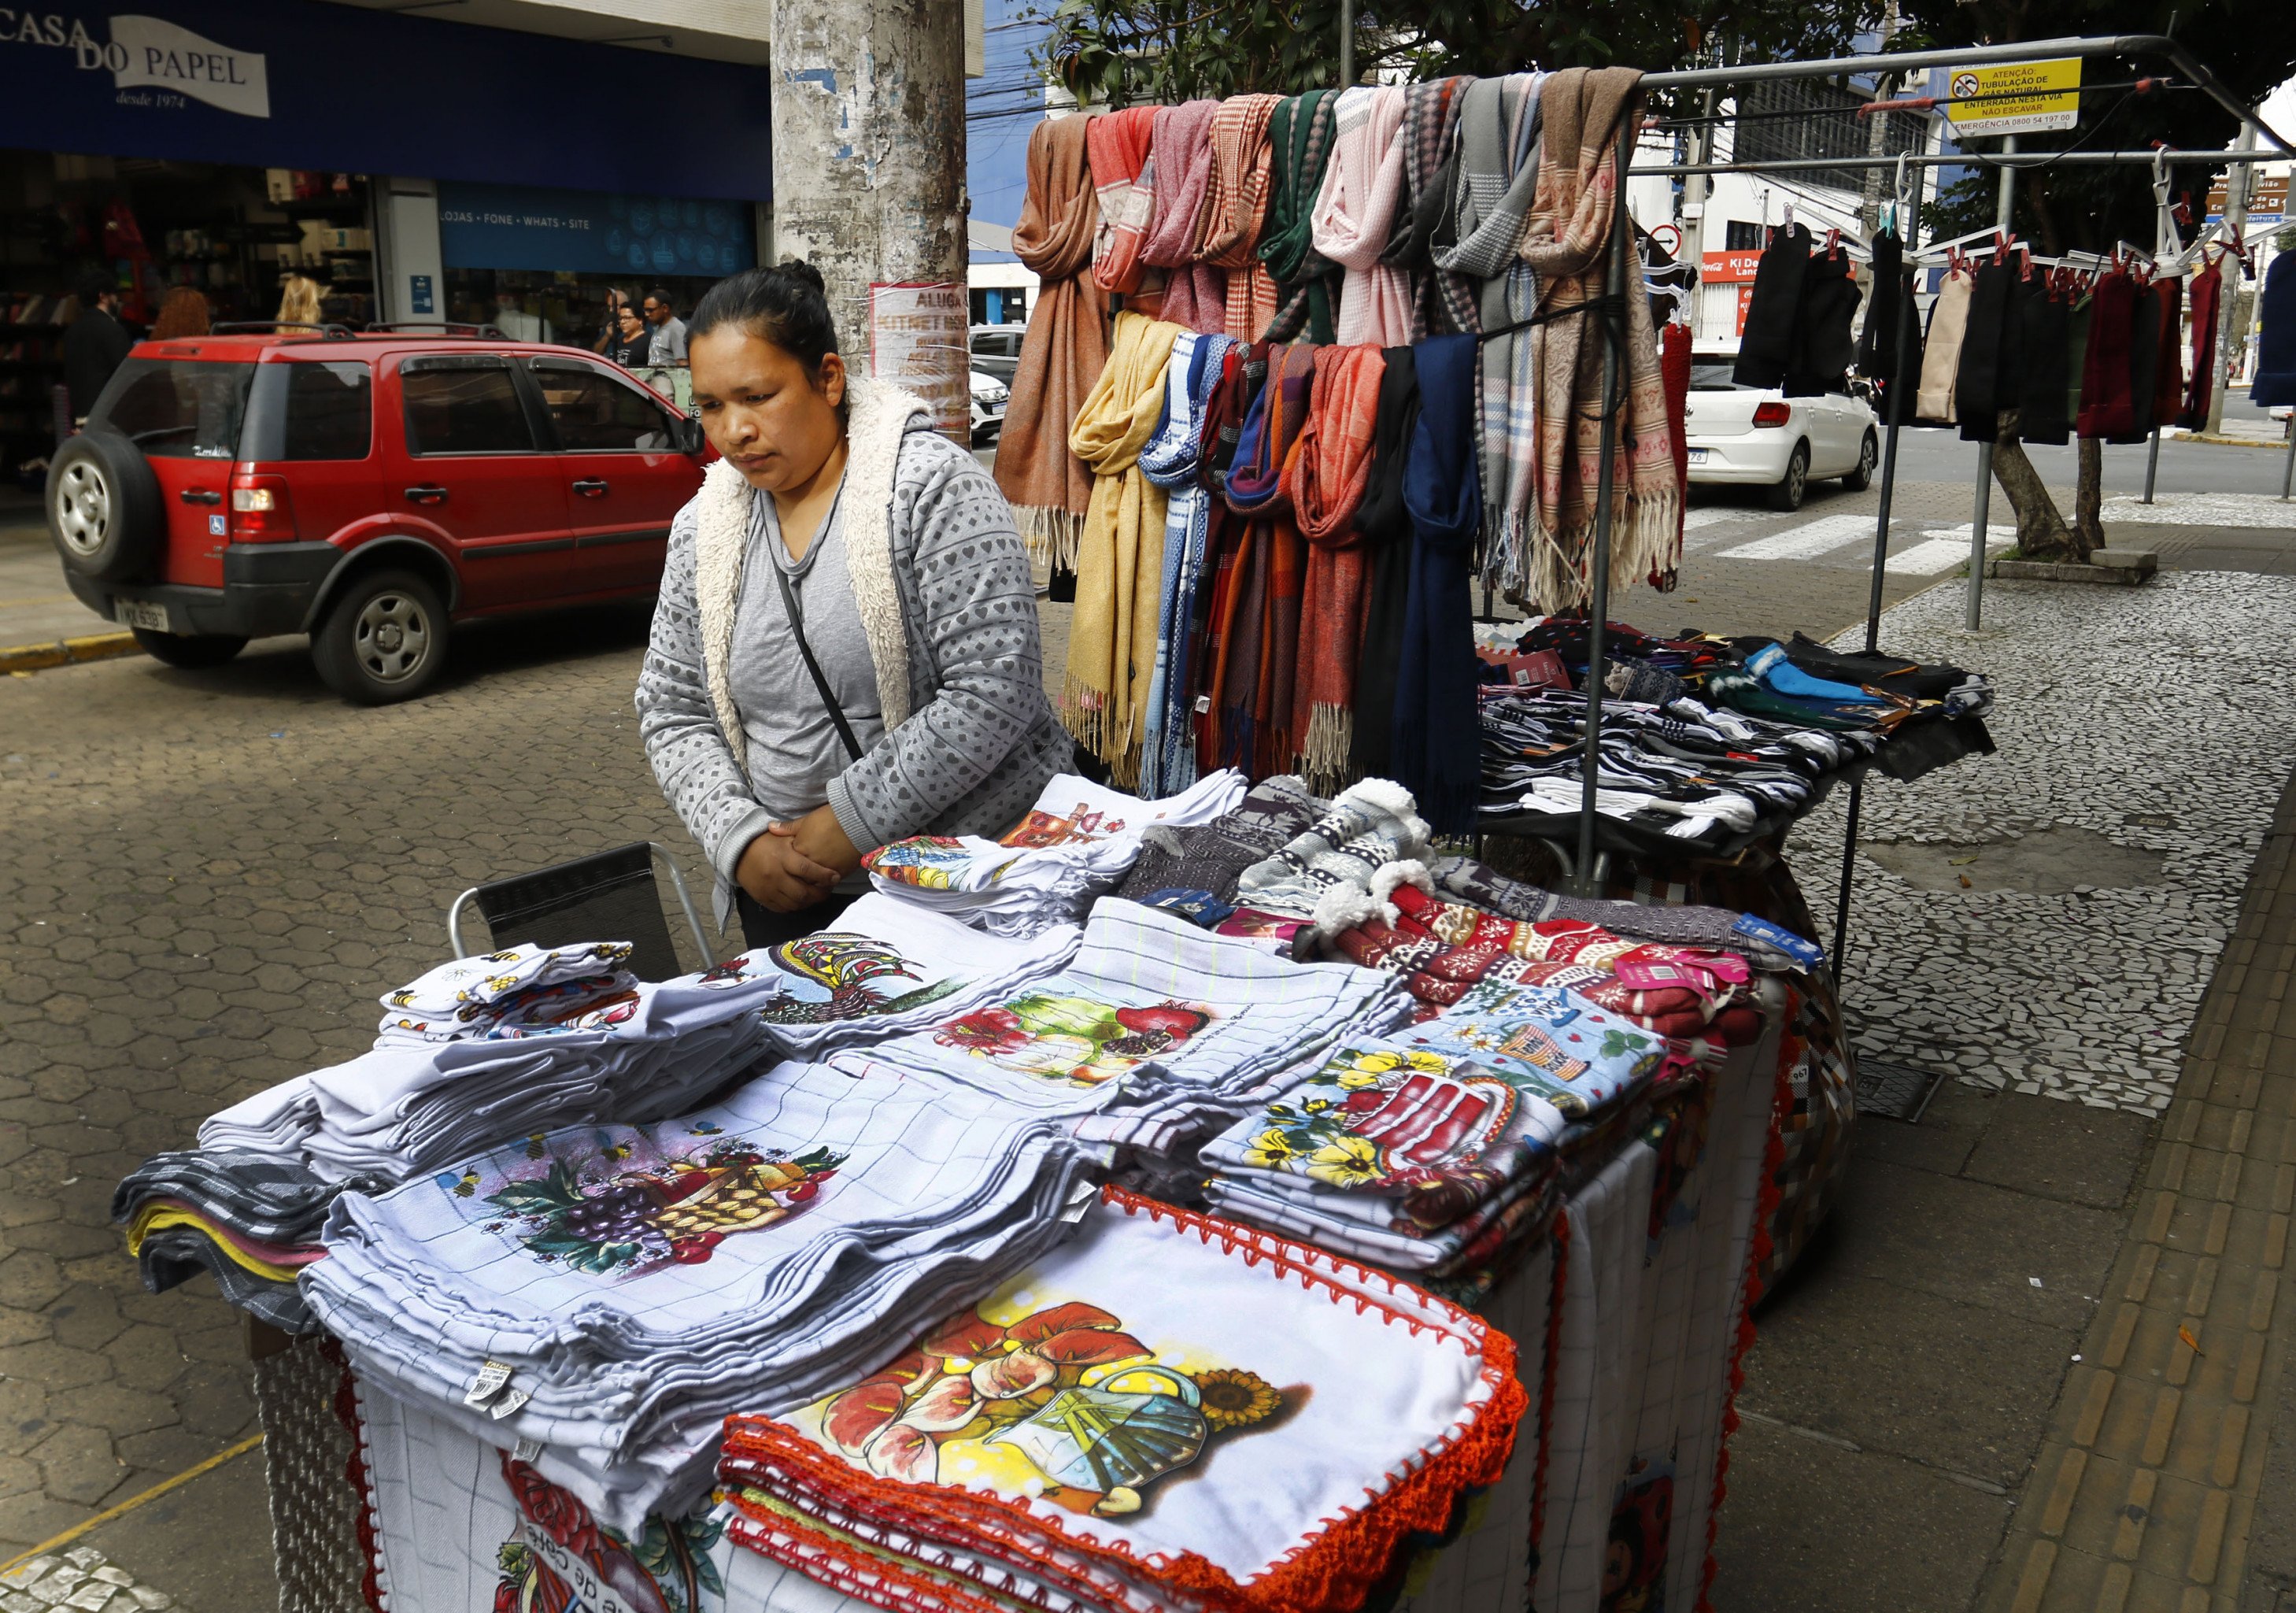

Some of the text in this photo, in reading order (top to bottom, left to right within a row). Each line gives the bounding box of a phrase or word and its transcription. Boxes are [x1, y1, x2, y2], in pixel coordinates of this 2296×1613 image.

[0, 8, 91, 49] CASA
[76, 40, 246, 85] DO PAPEL
[1993, 68, 2036, 80] ATENÇÃO:
[1981, 77, 2034, 89] TUBULAÇÃO
[116, 91, 186, 109] desde 1974
[1965, 98, 2016, 109] ENTERRADA
[2018, 94, 2046, 104] NESTA
[2002, 104, 2043, 114] ESCAVAR
[1955, 120, 2009, 131] EMERGÊNCIA
[2012, 117, 2031, 126] 0800
[439, 211, 590, 230] LOJAS FONE WHATS SITE
[1730, 259, 1741, 268] Ki
[1793, 1067, 1807, 1080] 967
[575, 1567, 597, 1600] de
